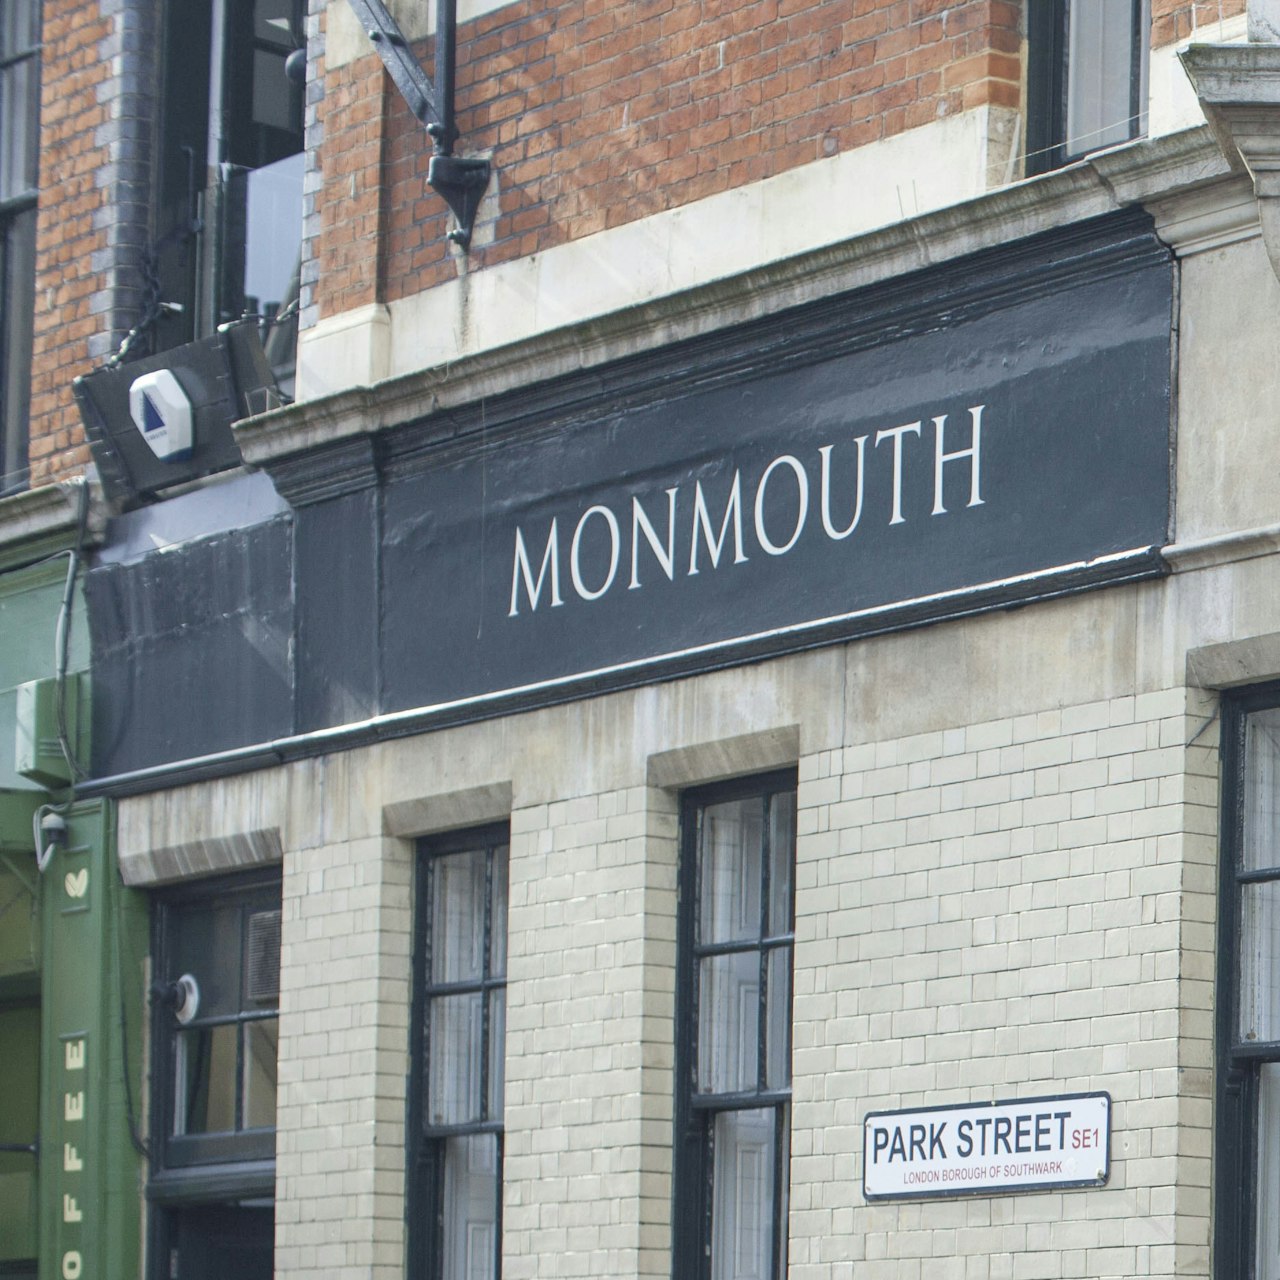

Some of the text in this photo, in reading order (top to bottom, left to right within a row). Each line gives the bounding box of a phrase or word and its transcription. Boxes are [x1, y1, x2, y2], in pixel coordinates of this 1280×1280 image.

[508, 404, 986, 617] MONMOUTH
[873, 1111, 1099, 1165] PARK STREET SE1
[903, 1160, 1063, 1185] LONDON BOROUGH OF SOUTHWARK
